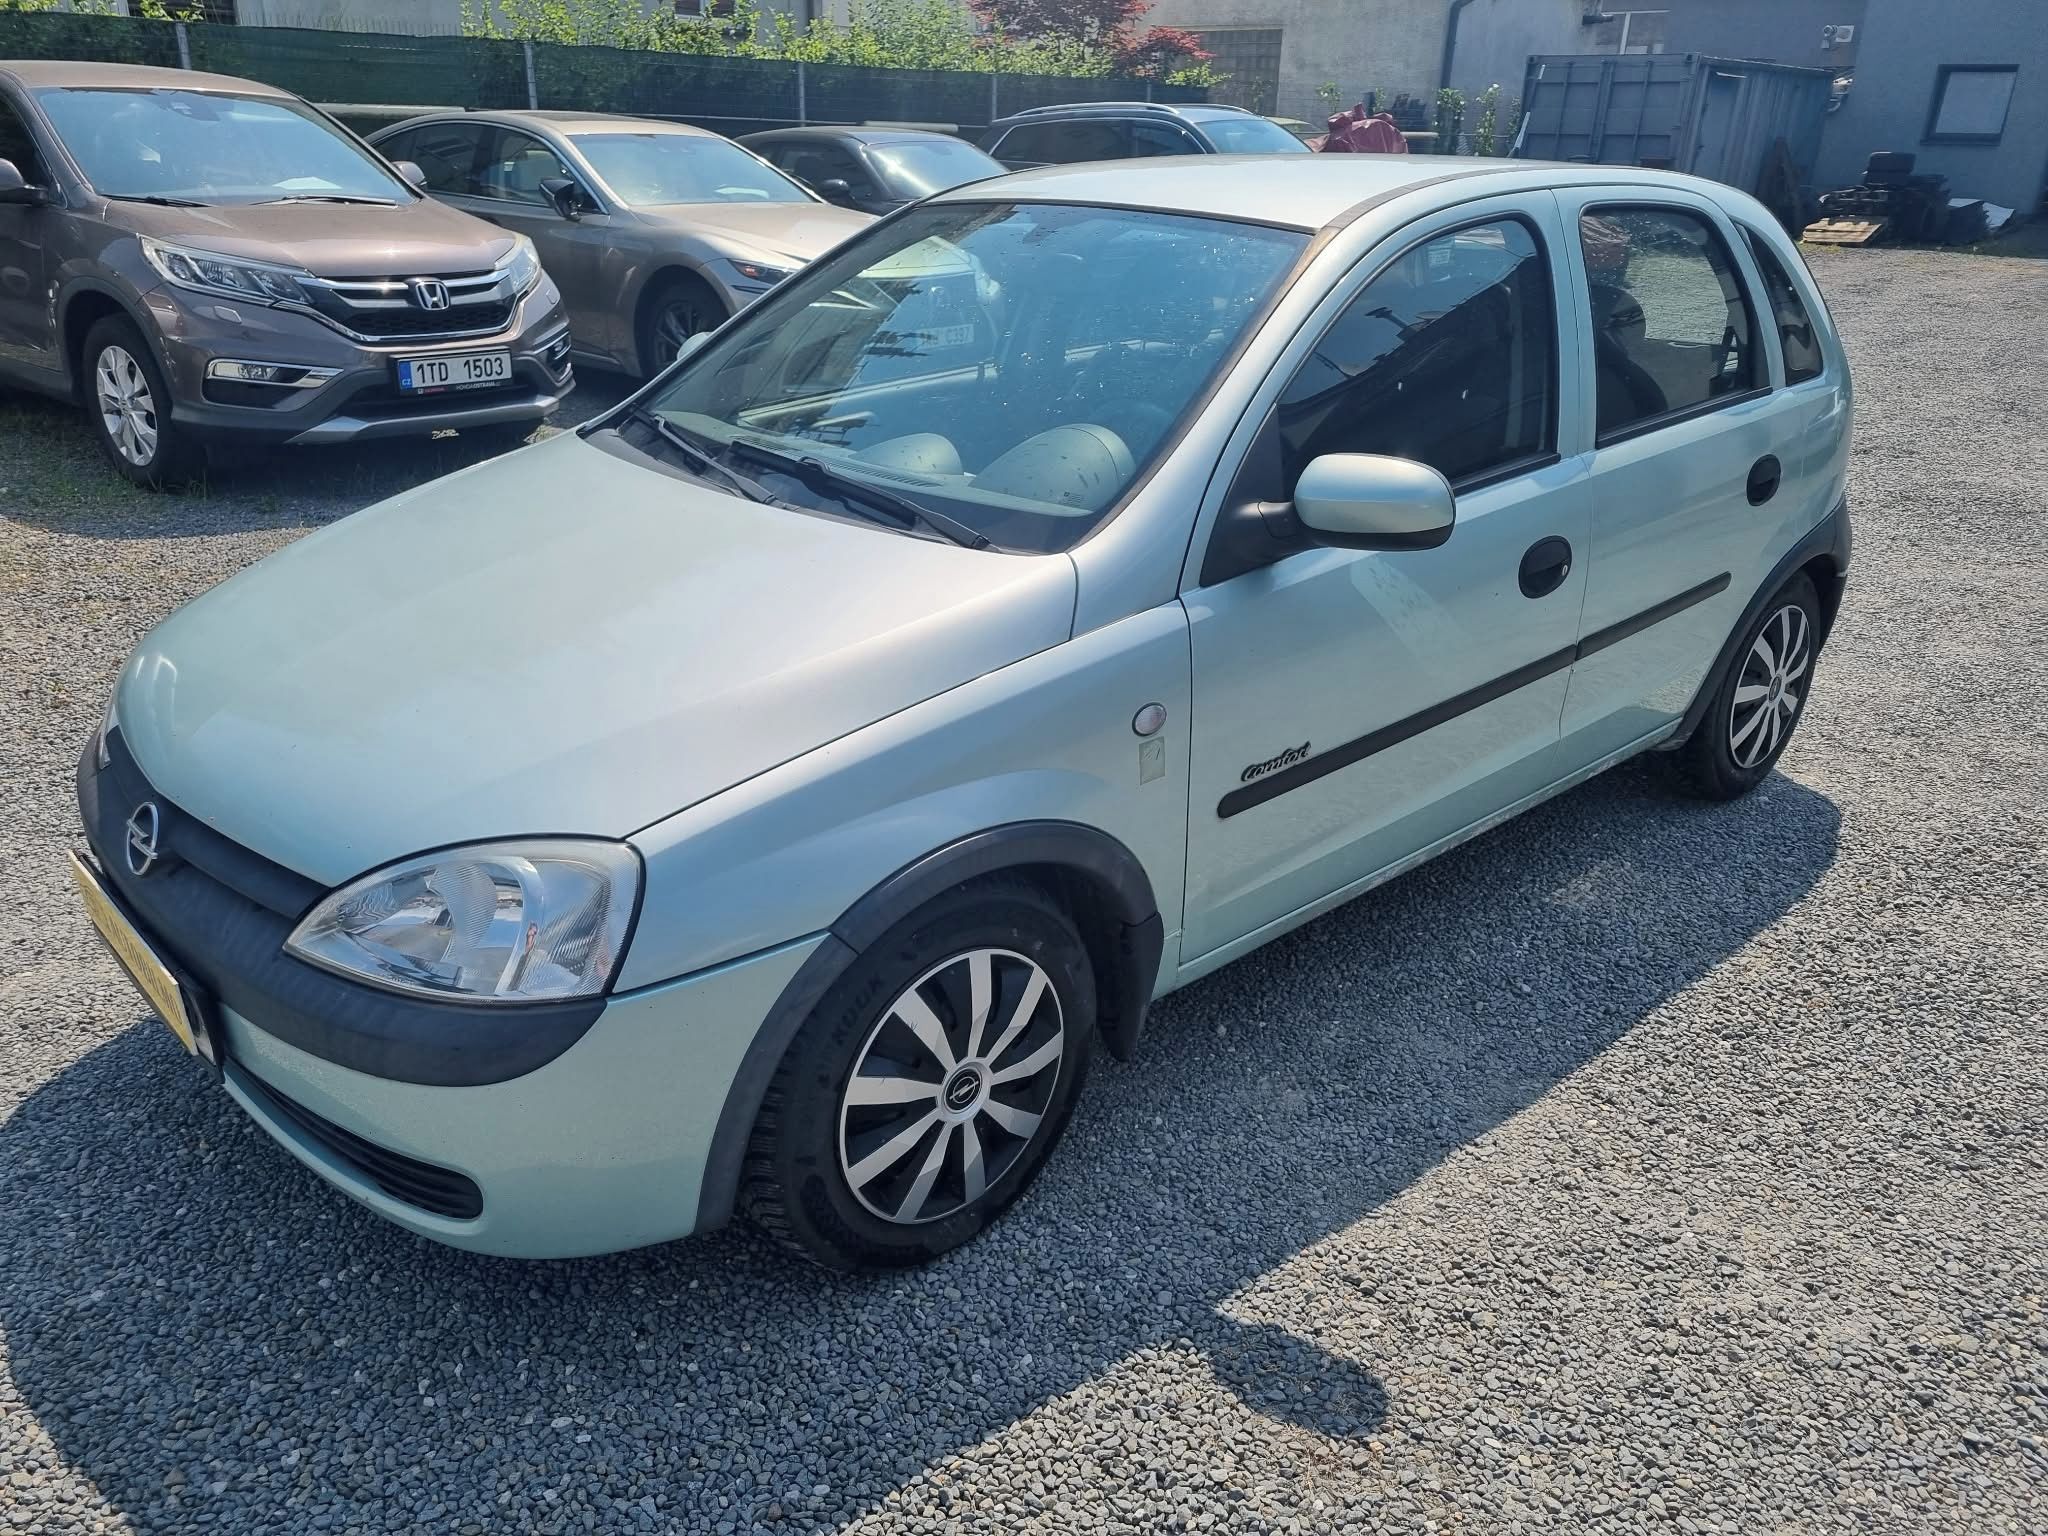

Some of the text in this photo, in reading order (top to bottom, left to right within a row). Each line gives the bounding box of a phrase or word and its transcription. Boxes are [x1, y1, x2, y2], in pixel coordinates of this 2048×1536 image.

[417, 357, 504, 384] 1TD 1503
[1240, 740, 1311, 782] Comfort
